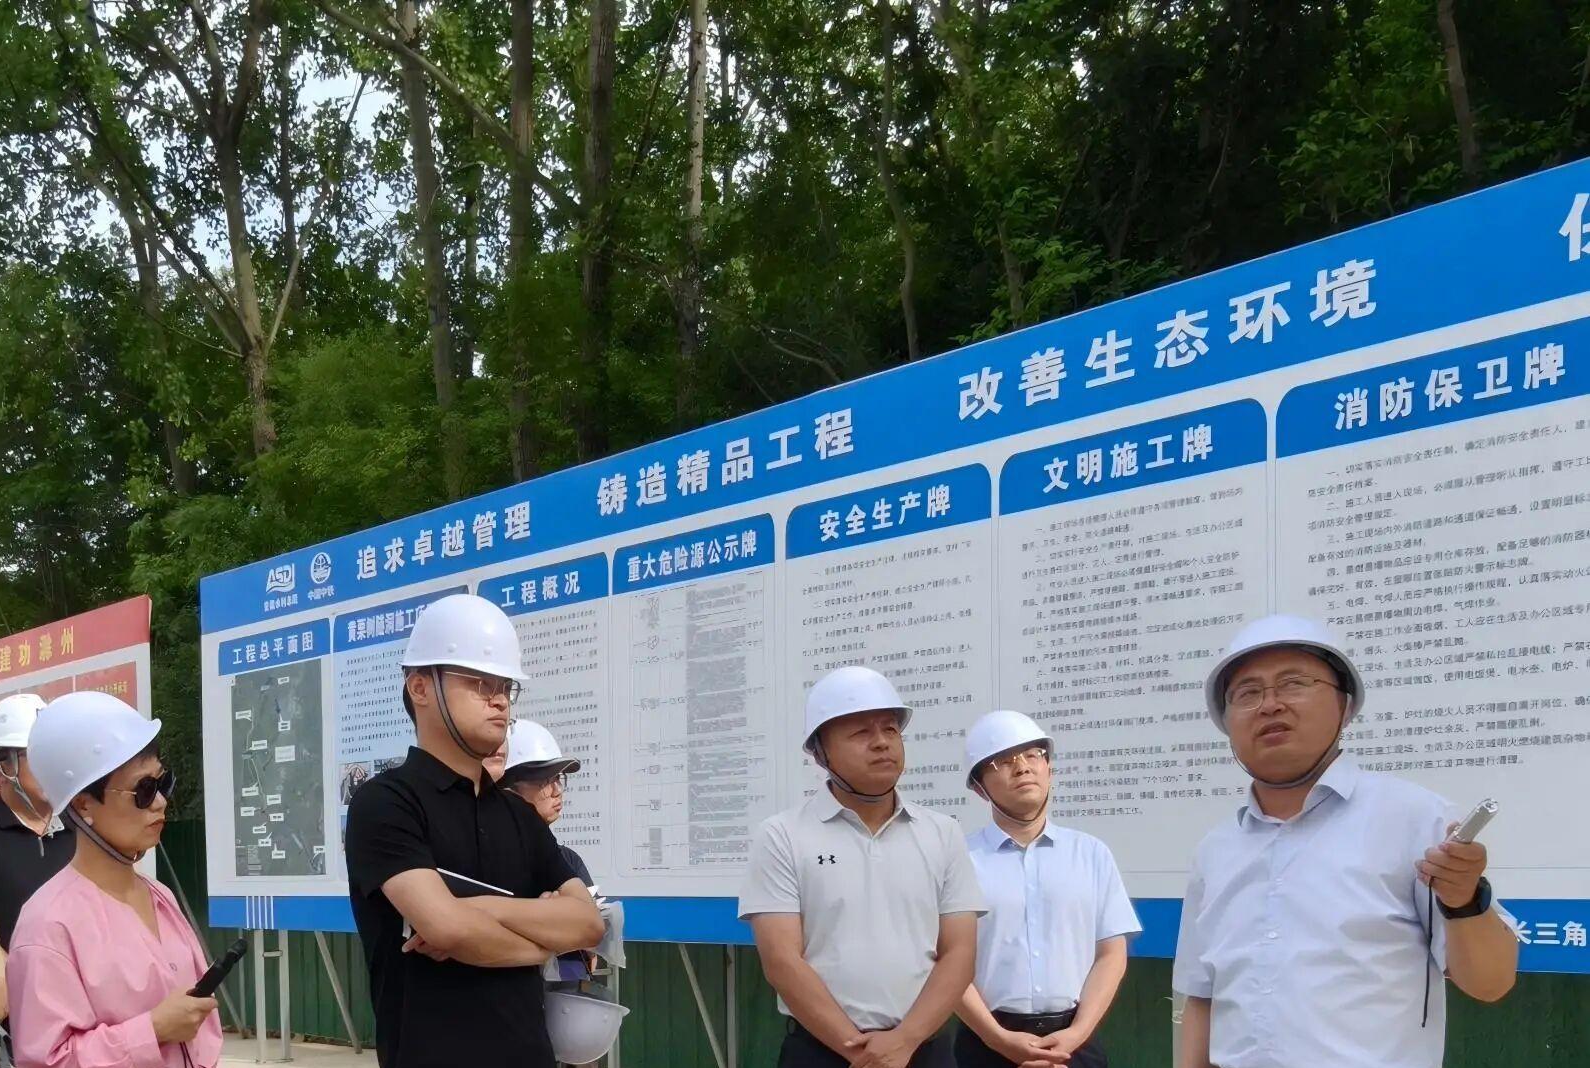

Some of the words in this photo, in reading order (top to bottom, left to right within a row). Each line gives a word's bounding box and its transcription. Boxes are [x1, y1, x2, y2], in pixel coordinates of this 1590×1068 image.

[958, 257, 1377, 421] 改善生态环境
[1335, 343, 1566, 430] 消防保卫牌
[596, 408, 855, 517] 铸造精品工程
[1043, 424, 1213, 493] 文明施工牌
[356, 501, 531, 581] 追求卓越管理
[819, 485, 952, 542] 安全生产牌
[501, 571, 581, 607] 工程概况
[627, 530, 758, 582] 重大危险源公示牌
[233, 631, 314, 665] 工程总平面图
